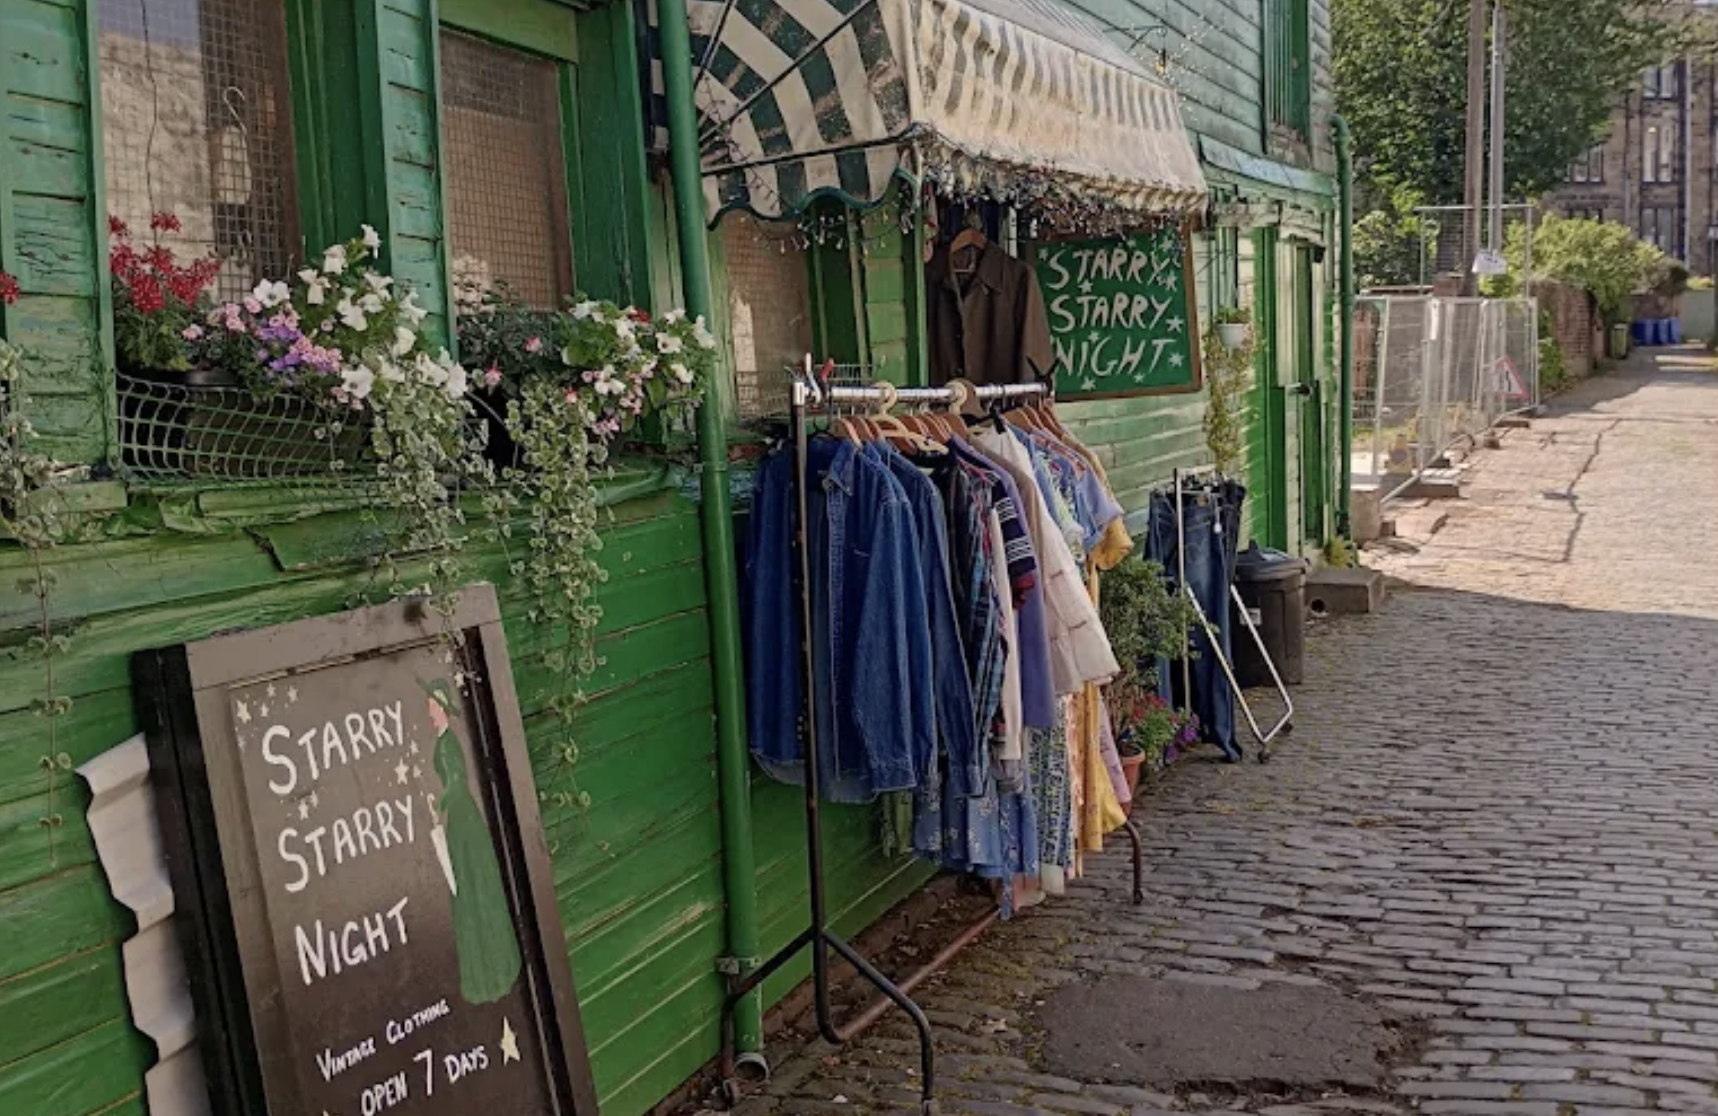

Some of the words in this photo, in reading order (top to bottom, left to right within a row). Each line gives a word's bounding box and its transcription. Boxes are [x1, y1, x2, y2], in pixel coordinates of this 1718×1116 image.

[1046, 249, 1170, 289] STARRY
[1051, 292, 1172, 333] STARRY
[1054, 336, 1176, 377] NIGHT
[262, 701, 402, 794] STARRY
[278, 795, 414, 892] STARRY
[295, 897, 409, 985] NIGHT
[316, 1037, 376, 1082] VINTAGE
[386, 998, 450, 1042] CLOTHING
[361, 1071, 408, 1116] OPEN
[413, 1050, 433, 1096] 7
[444, 1045, 489, 1081] DAYS
